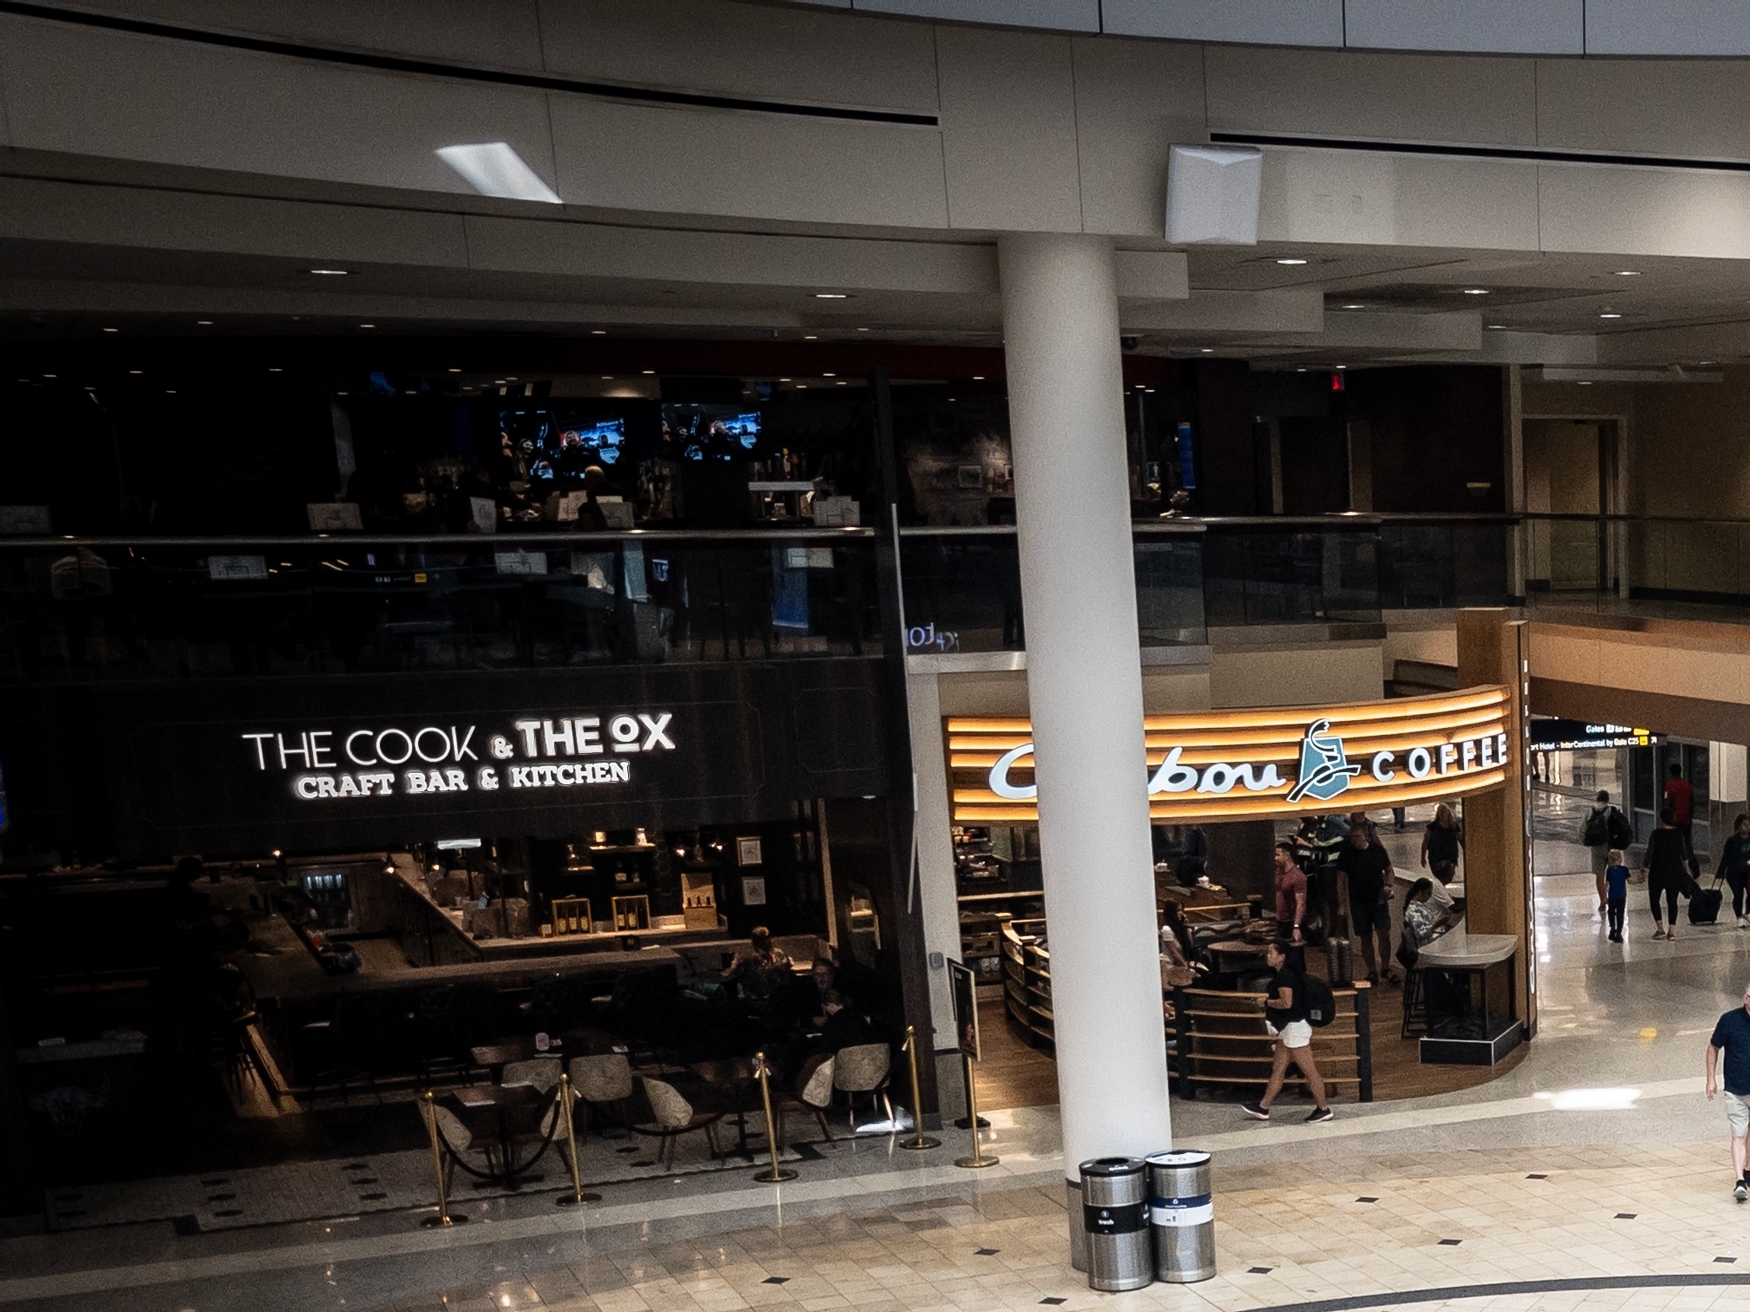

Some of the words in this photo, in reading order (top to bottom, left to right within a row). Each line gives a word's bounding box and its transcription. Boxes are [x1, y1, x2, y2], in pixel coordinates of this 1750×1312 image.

[241, 731, 337, 770] THE
[345, 725, 479, 764] COOK
[491, 734, 513, 760] &
[516, 717, 604, 758] THE
[610, 713, 676, 753] OX
[988, 743, 1286, 800] Cbou
[1371, 732, 1510, 783] COFFEE
[297, 772, 395, 800] CRAFT
[407, 768, 469, 794] BAR
[480, 767, 499, 790] &
[511, 761, 630, 788] KITCHEN
